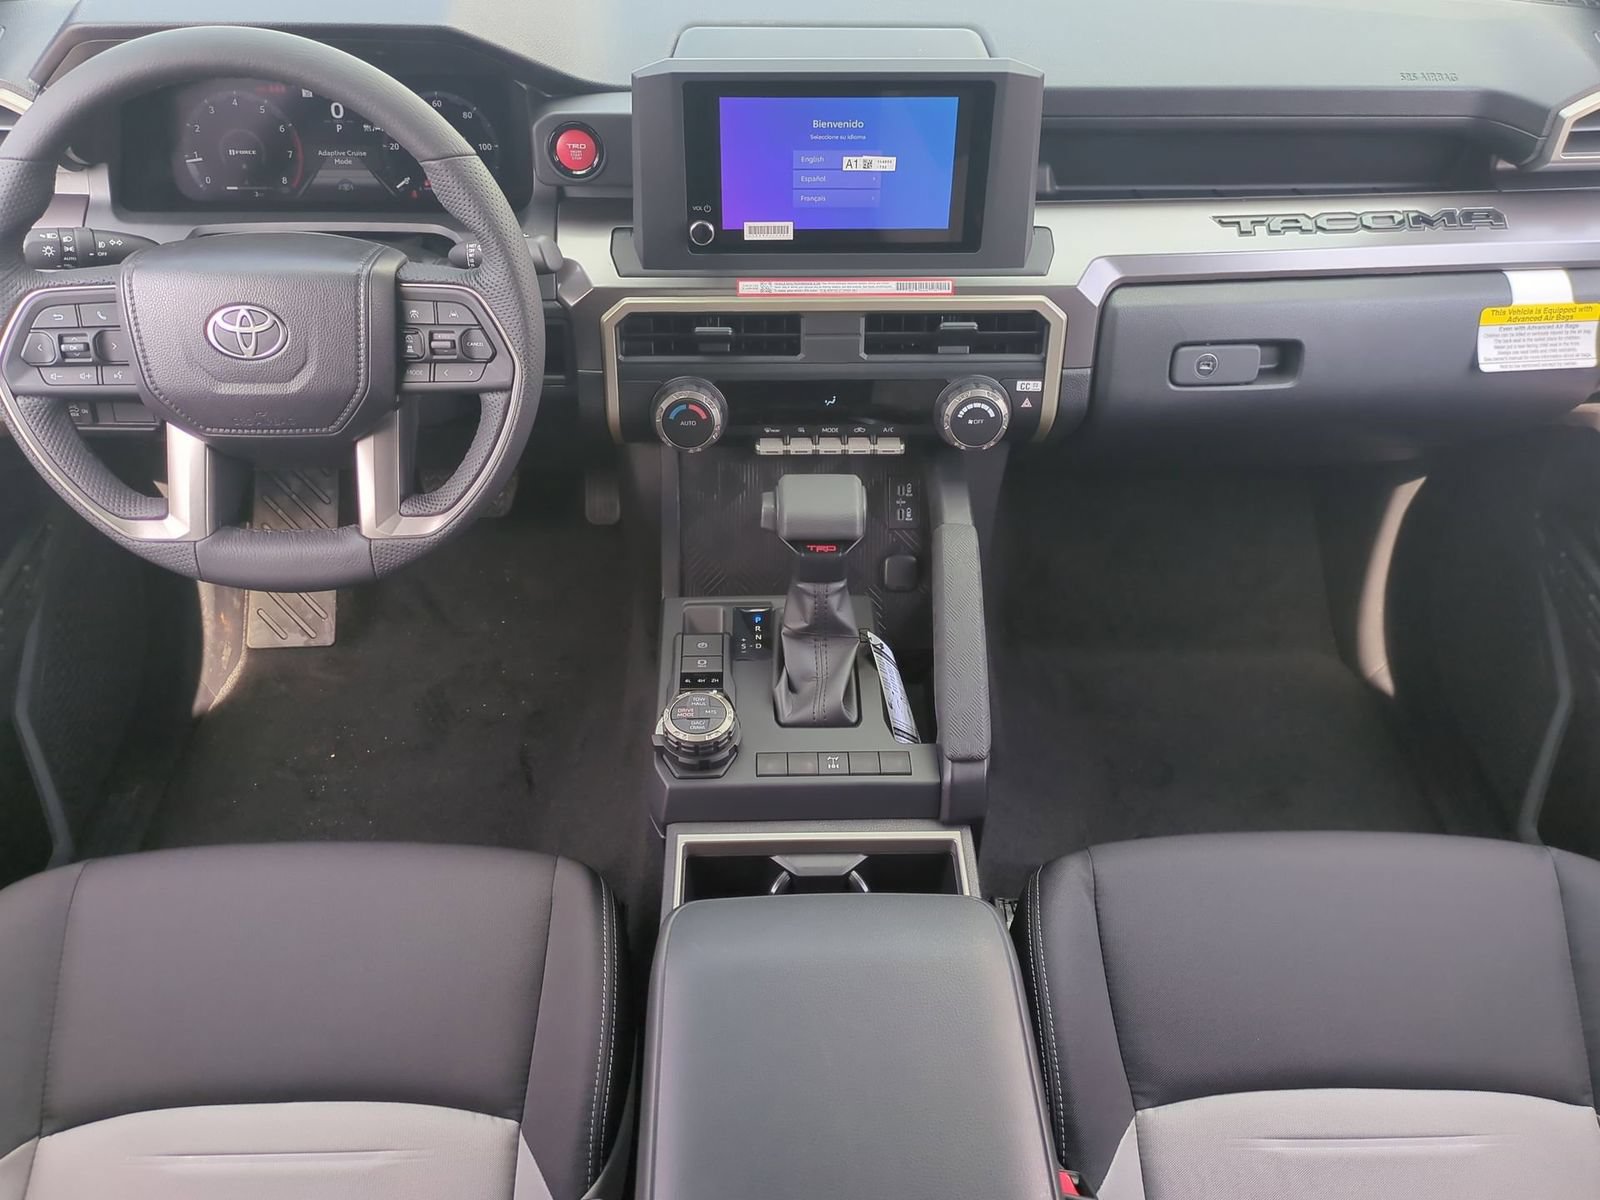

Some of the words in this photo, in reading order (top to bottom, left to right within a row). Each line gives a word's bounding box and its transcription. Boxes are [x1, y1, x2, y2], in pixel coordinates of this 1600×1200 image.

[232, 98, 238, 106] 4
[431, 100, 442, 108] 60
[208, 105, 215, 114] 3
[259, 105, 266, 114] 5
[330, 102, 344, 119] 0
[462, 111, 473, 119] 80
[194, 124, 201, 133] 2
[279, 124, 286, 133] 6
[336, 124, 343, 133] P
[812, 119, 864, 129] Bienvenido
[389, 143, 400, 151] 20
[478, 143, 492, 151] 100
[287, 150, 293, 159] 7
[800, 156, 825, 164] English
[845, 158, 858, 169] A1
[205, 176, 211, 184] 0
[281, 176, 288, 185] 8
[800, 175, 826, 183] Español
[800, 195, 826, 203] Français
[1211, 207, 1509, 236] TACOMA
[1490, 309, 1506, 317] This
[1508, 308, 1534, 316] Vehicle
[1543, 306, 1577, 316] Equipped
[1506, 315, 1542, 323] Advanced
[1555, 314, 1574, 322] Bags
[1020, 382, 1031, 391] CC
[806, 544, 837, 553] TRD
[755, 616, 762, 624] P
